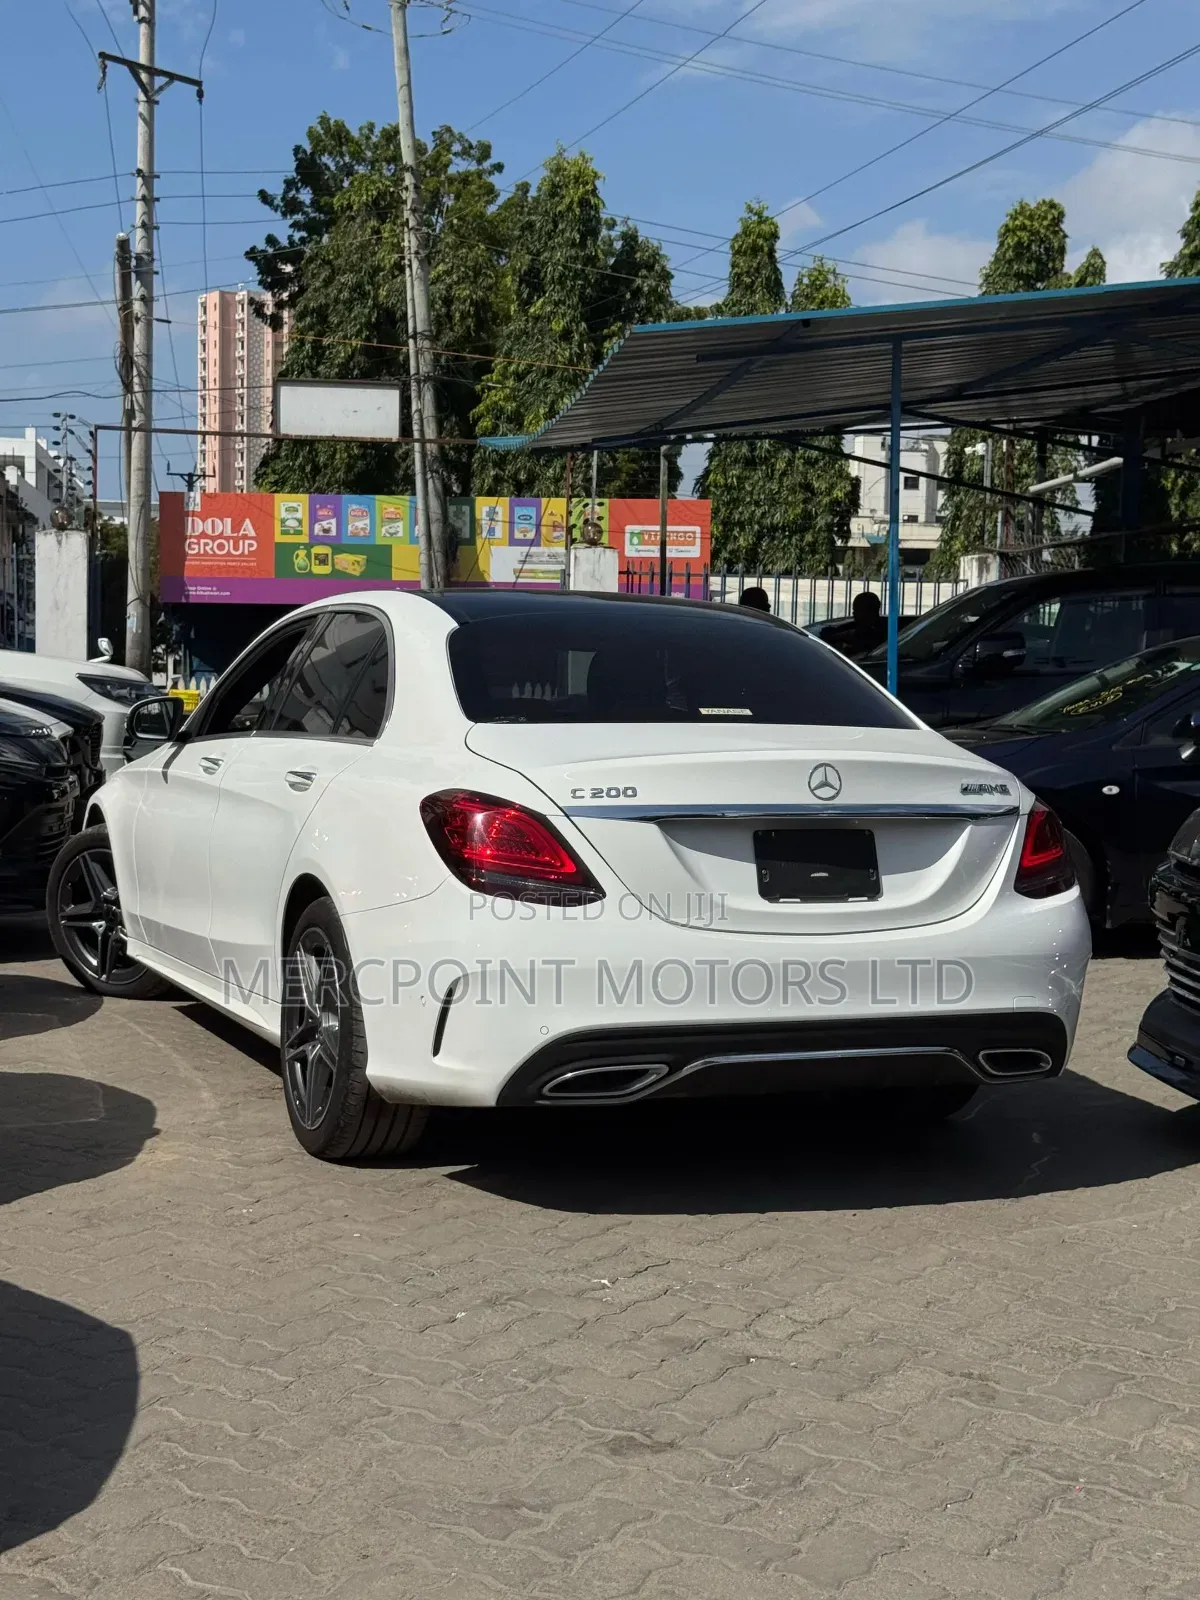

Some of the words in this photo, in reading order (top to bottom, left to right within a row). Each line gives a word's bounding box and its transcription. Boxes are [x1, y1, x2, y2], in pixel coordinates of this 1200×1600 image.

[184, 517, 257, 537] DOLA
[185, 538, 258, 556] GROUP
[570, 788, 586, 800] C
[589, 786, 638, 799] 200
